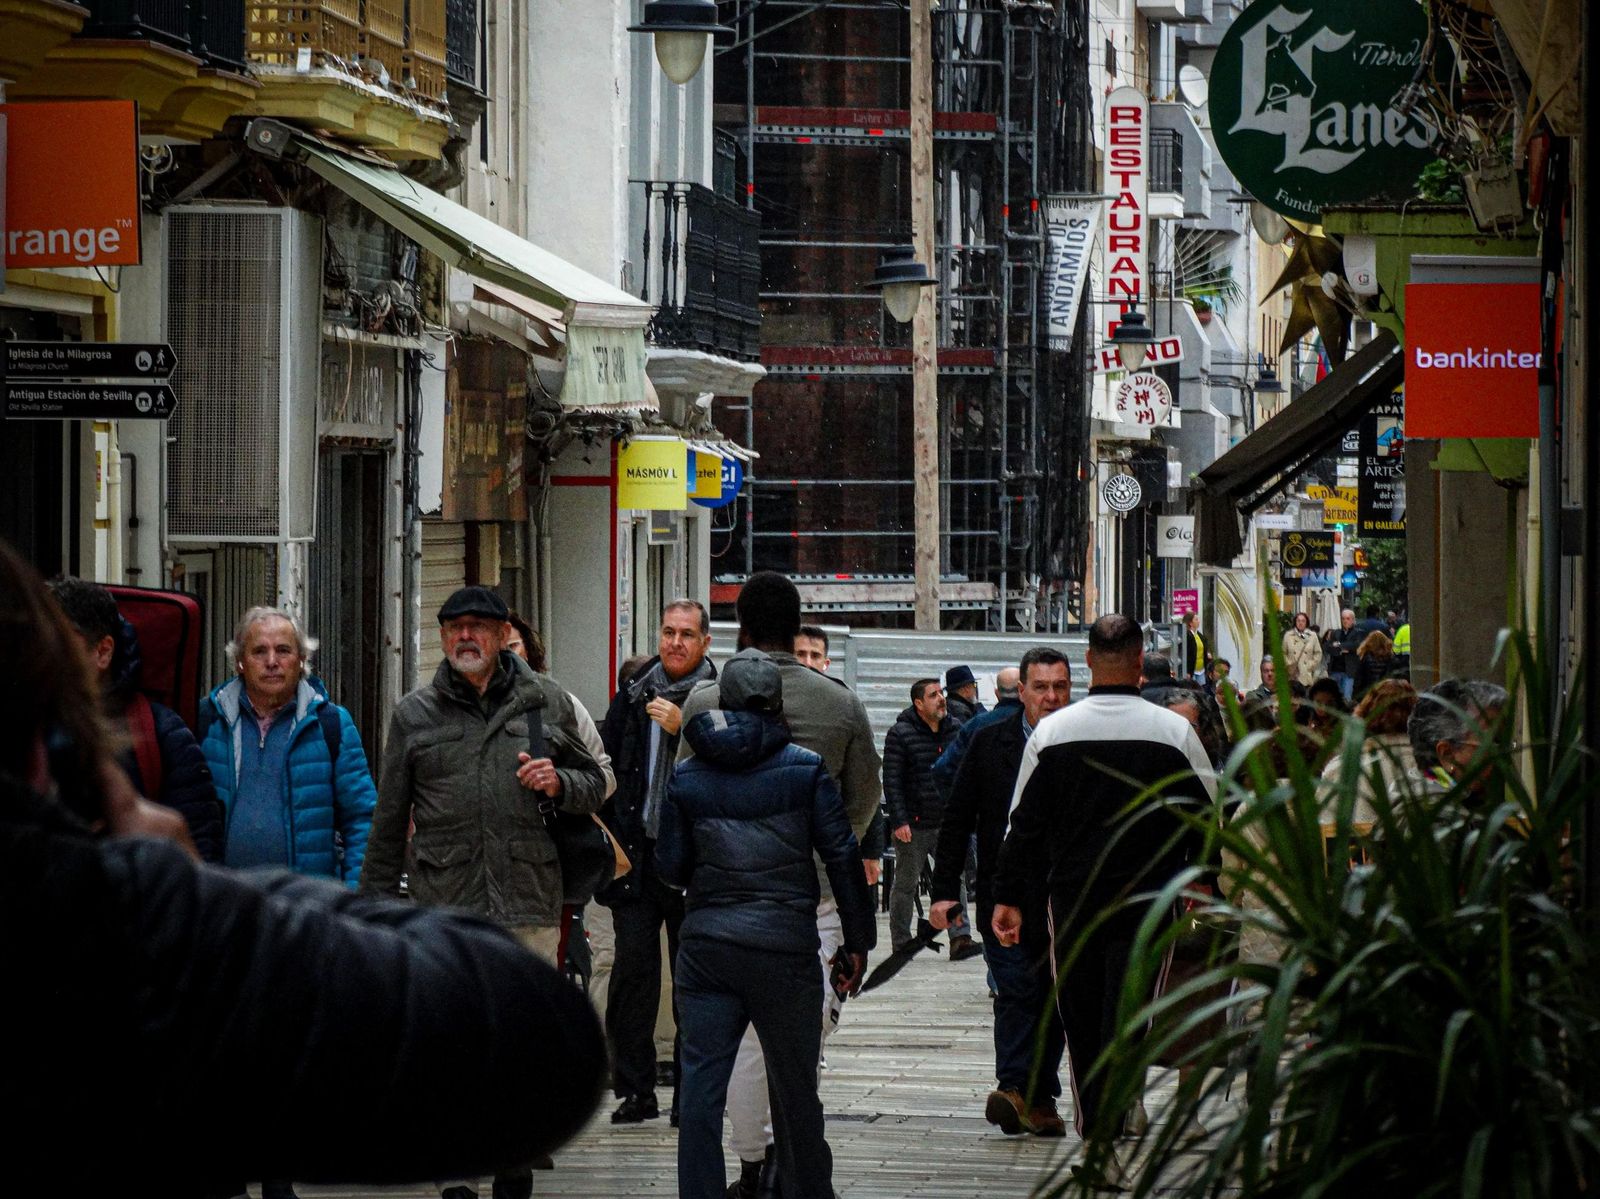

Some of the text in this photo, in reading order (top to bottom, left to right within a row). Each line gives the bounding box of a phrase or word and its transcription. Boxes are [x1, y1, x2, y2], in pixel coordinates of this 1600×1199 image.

[1274, 187, 1328, 214] Funda
[1047, 218, 1068, 238] DE
[1051, 218, 1090, 327] ANDAMIOS
[9, 348, 112, 362] Iglesia de la Milagrosa
[1415, 347, 1542, 368] bankinter
[9, 389, 133, 401] Antigua Estación de Sevilla
[1366, 456, 1379, 465] EL
[1364, 520, 1374, 530] EN
